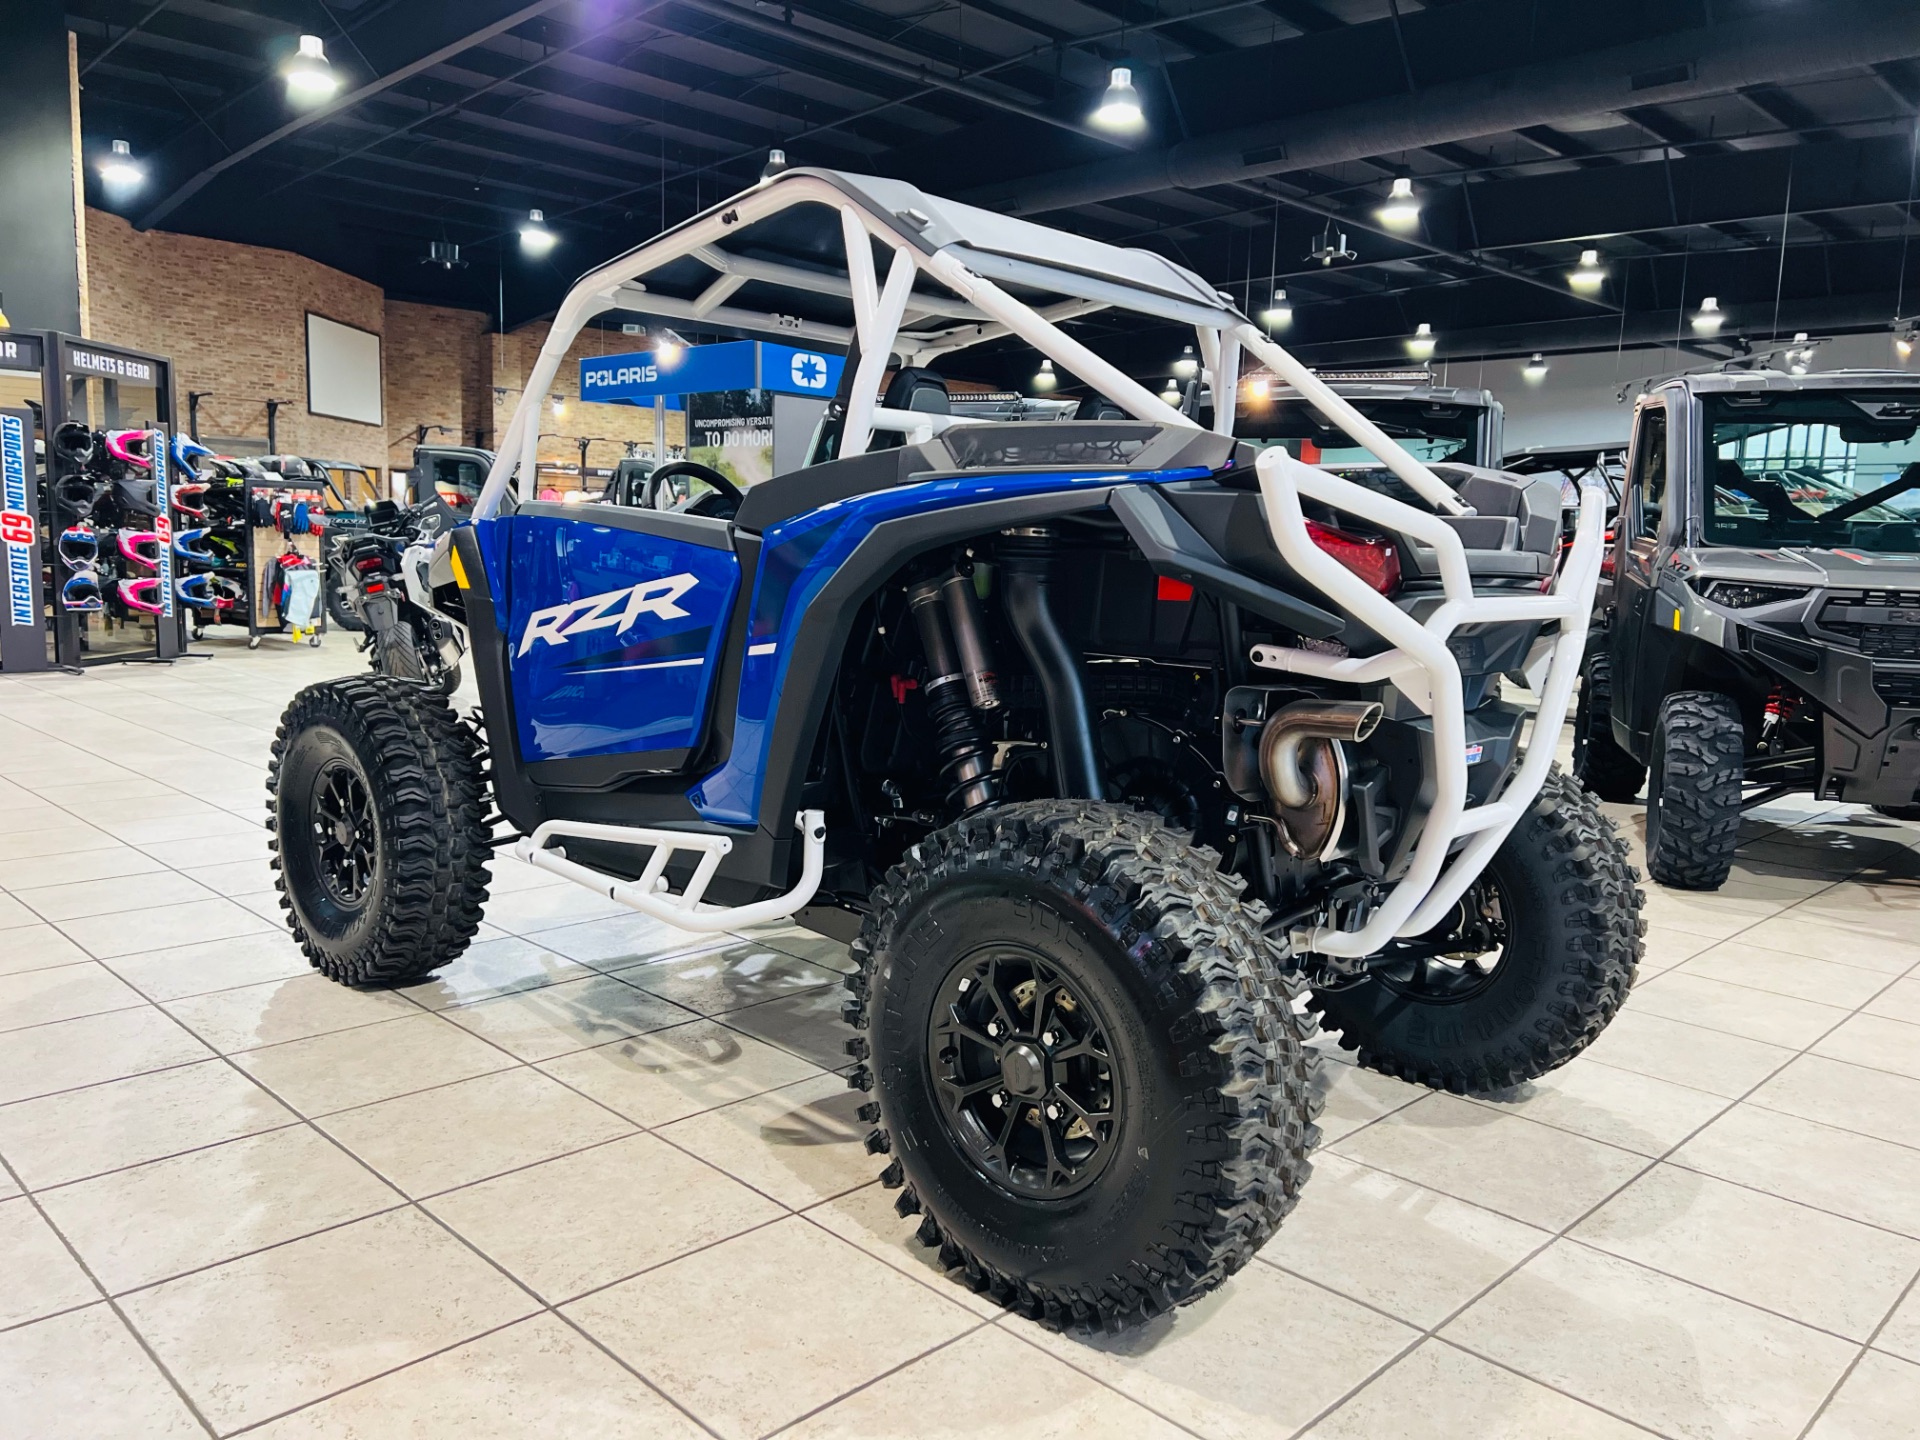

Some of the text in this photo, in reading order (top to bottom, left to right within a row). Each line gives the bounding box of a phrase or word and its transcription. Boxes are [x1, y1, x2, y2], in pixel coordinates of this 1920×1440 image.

[73, 350, 150, 380] HELMETS & GEAR
[585, 365, 658, 388] POLARIS
[694, 417, 745, 428] UNCOMPROMISING
[705, 431, 720, 448] TO
[723, 430, 740, 447] DO
[1, 417, 33, 624] INTERSTATE 69 MOTORSPORTS
[156, 515, 171, 543] 69
[1668, 559, 1690, 573] XP
[161, 545, 172, 617] INTERSTATE
[517, 572, 700, 659] RZR
